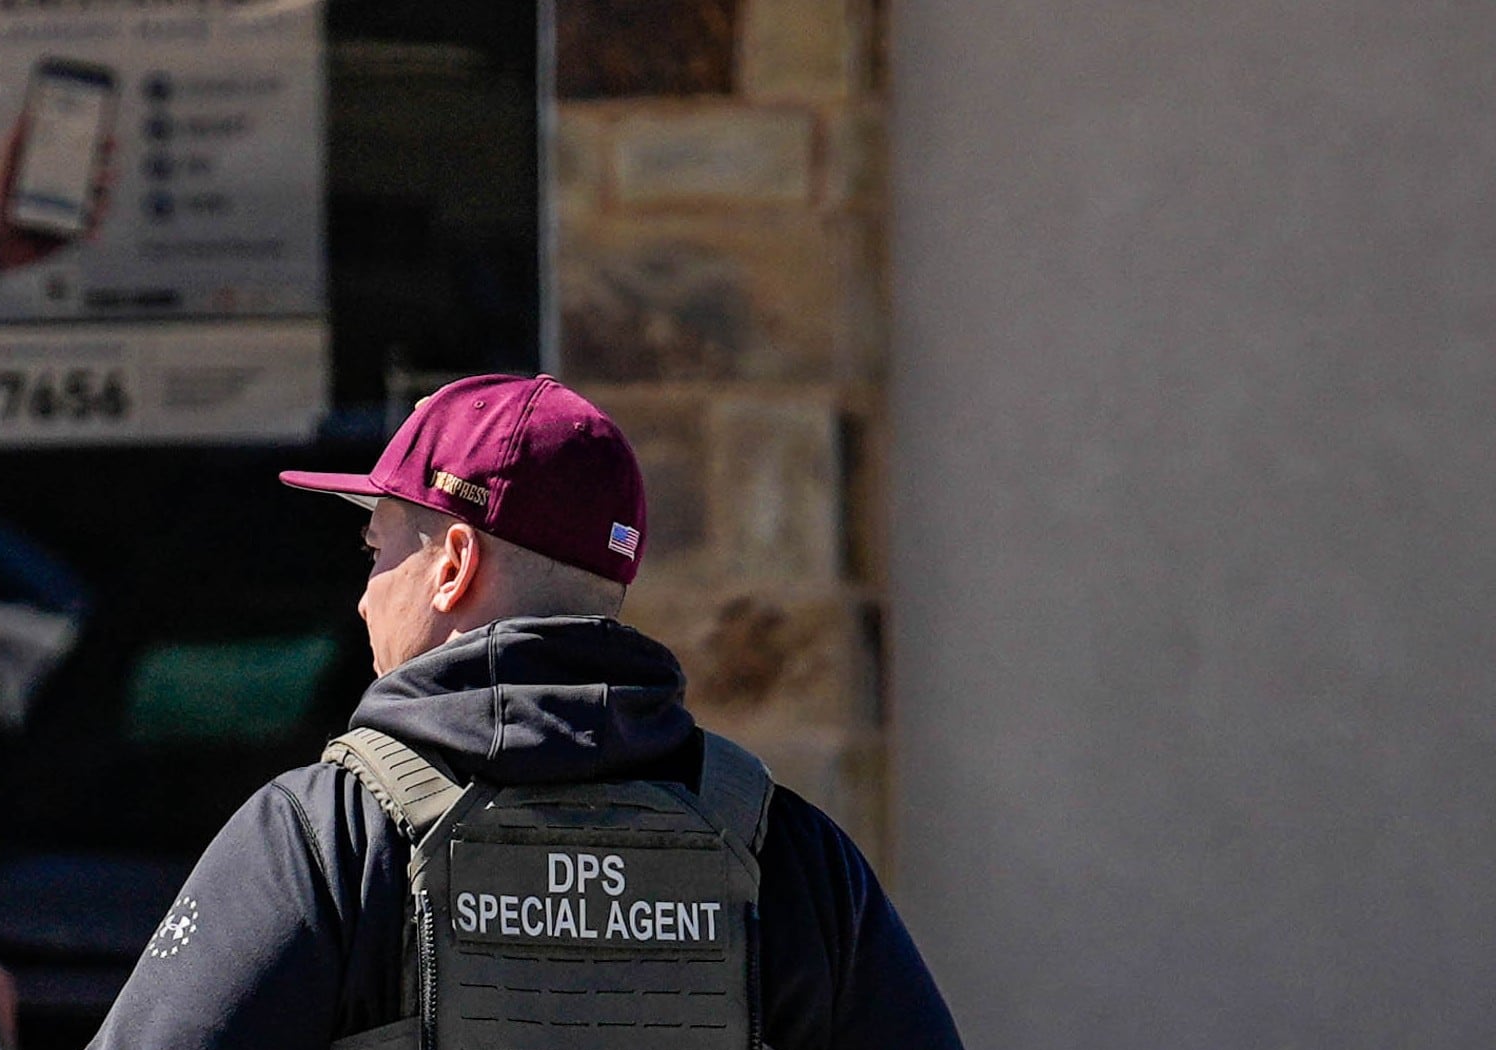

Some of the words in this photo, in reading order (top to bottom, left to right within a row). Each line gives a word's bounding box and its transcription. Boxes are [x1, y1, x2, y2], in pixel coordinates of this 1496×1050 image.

[547, 852, 626, 896] DPS
[456, 892, 598, 939] SPECIAL
[605, 900, 721, 941] AGENT
